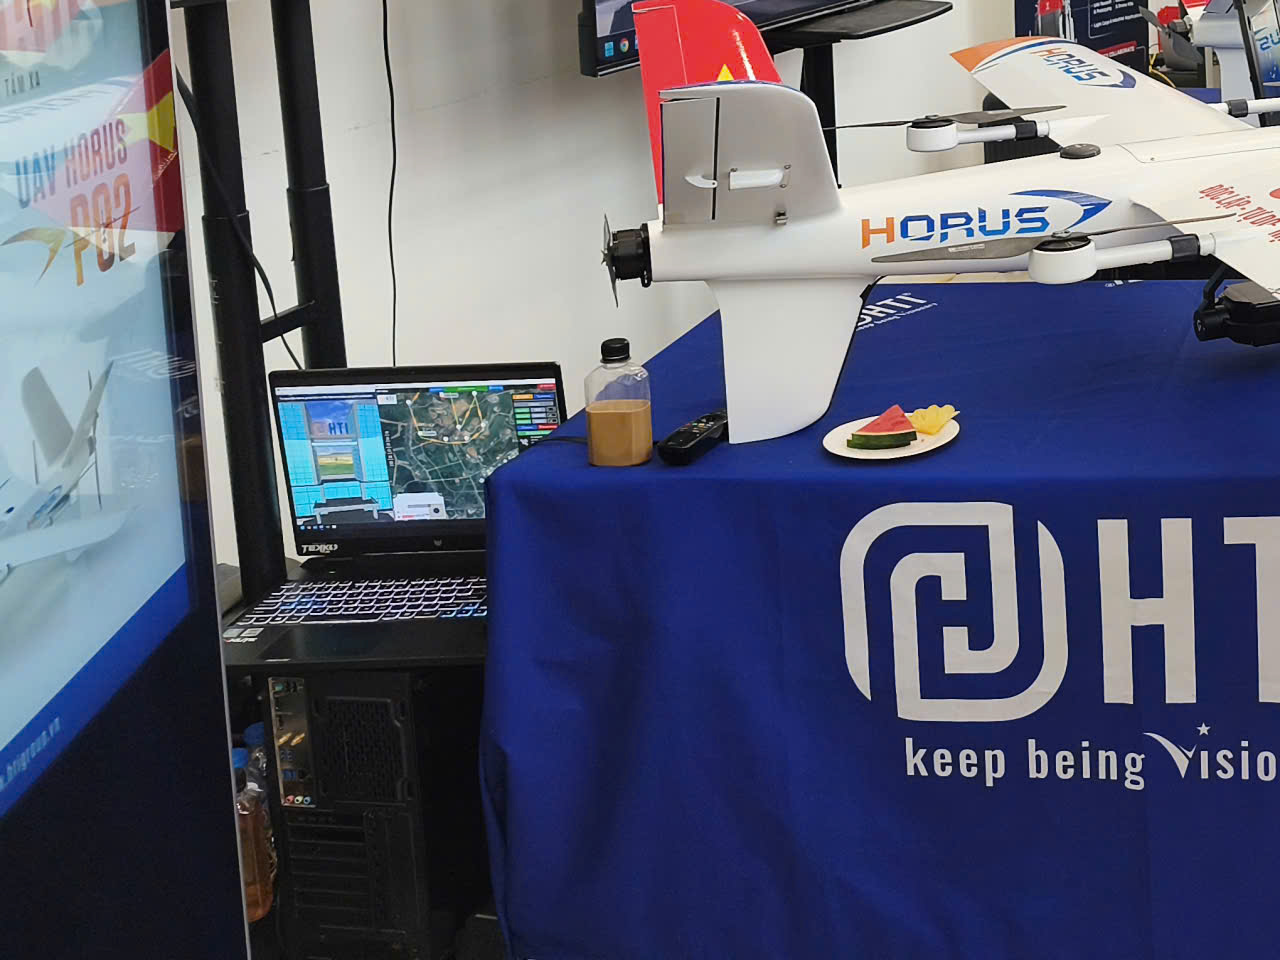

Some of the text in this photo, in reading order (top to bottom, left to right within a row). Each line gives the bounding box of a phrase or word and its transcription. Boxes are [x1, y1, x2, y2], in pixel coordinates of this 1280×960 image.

[1029, 47, 1111, 82] HORUS
[15, 146, 56, 209] UAV
[64, 118, 128, 188] HORUS
[861, 206, 1051, 249] HORUS
[328, 421, 350, 436] HTI
[905, 737, 1006, 787] keep
[1028, 738, 1145, 791] being
